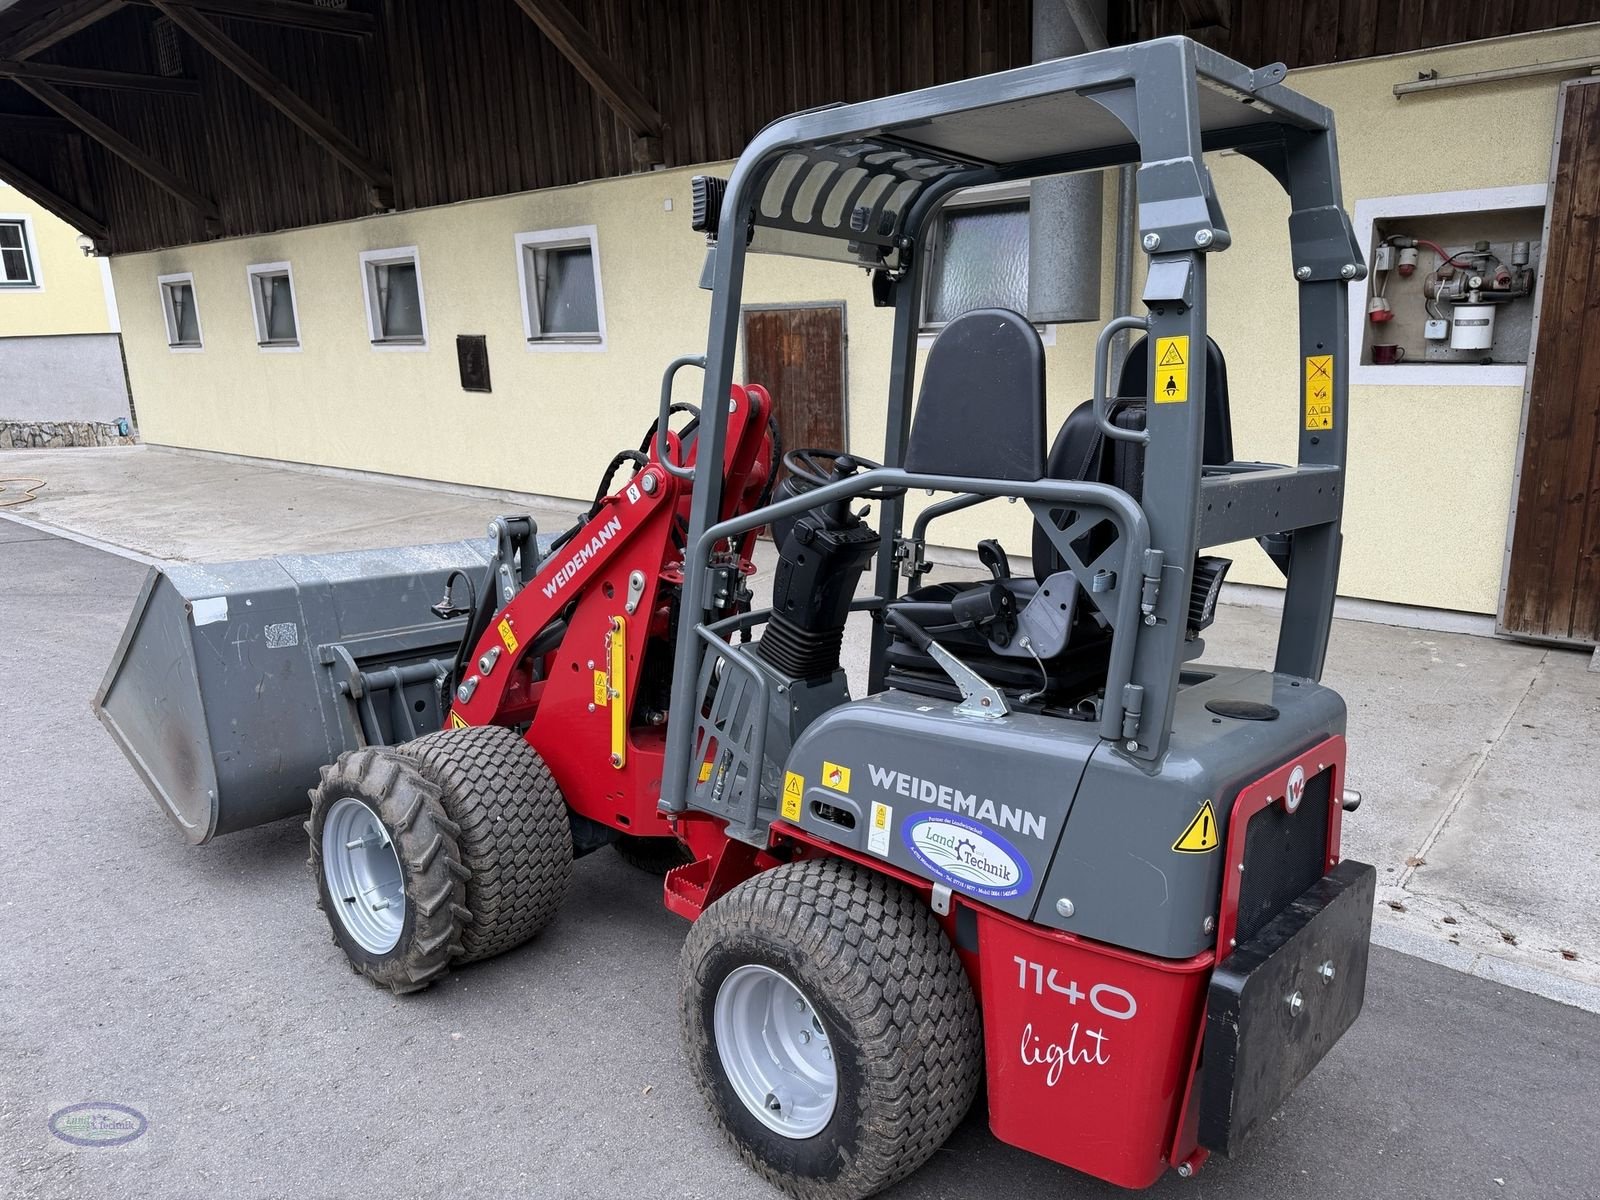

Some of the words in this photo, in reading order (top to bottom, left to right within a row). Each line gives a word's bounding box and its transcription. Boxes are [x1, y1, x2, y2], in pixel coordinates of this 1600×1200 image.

[542, 515, 622, 599] WEIDEMANN
[868, 763, 1047, 841] WEIDEMANN
[951, 819, 983, 836] Landwirtschaft
[926, 827, 955, 849] Land
[964, 851, 1011, 882] Technik
[1013, 955, 1137, 1020] 1140
[1020, 1022, 1111, 1087] light
